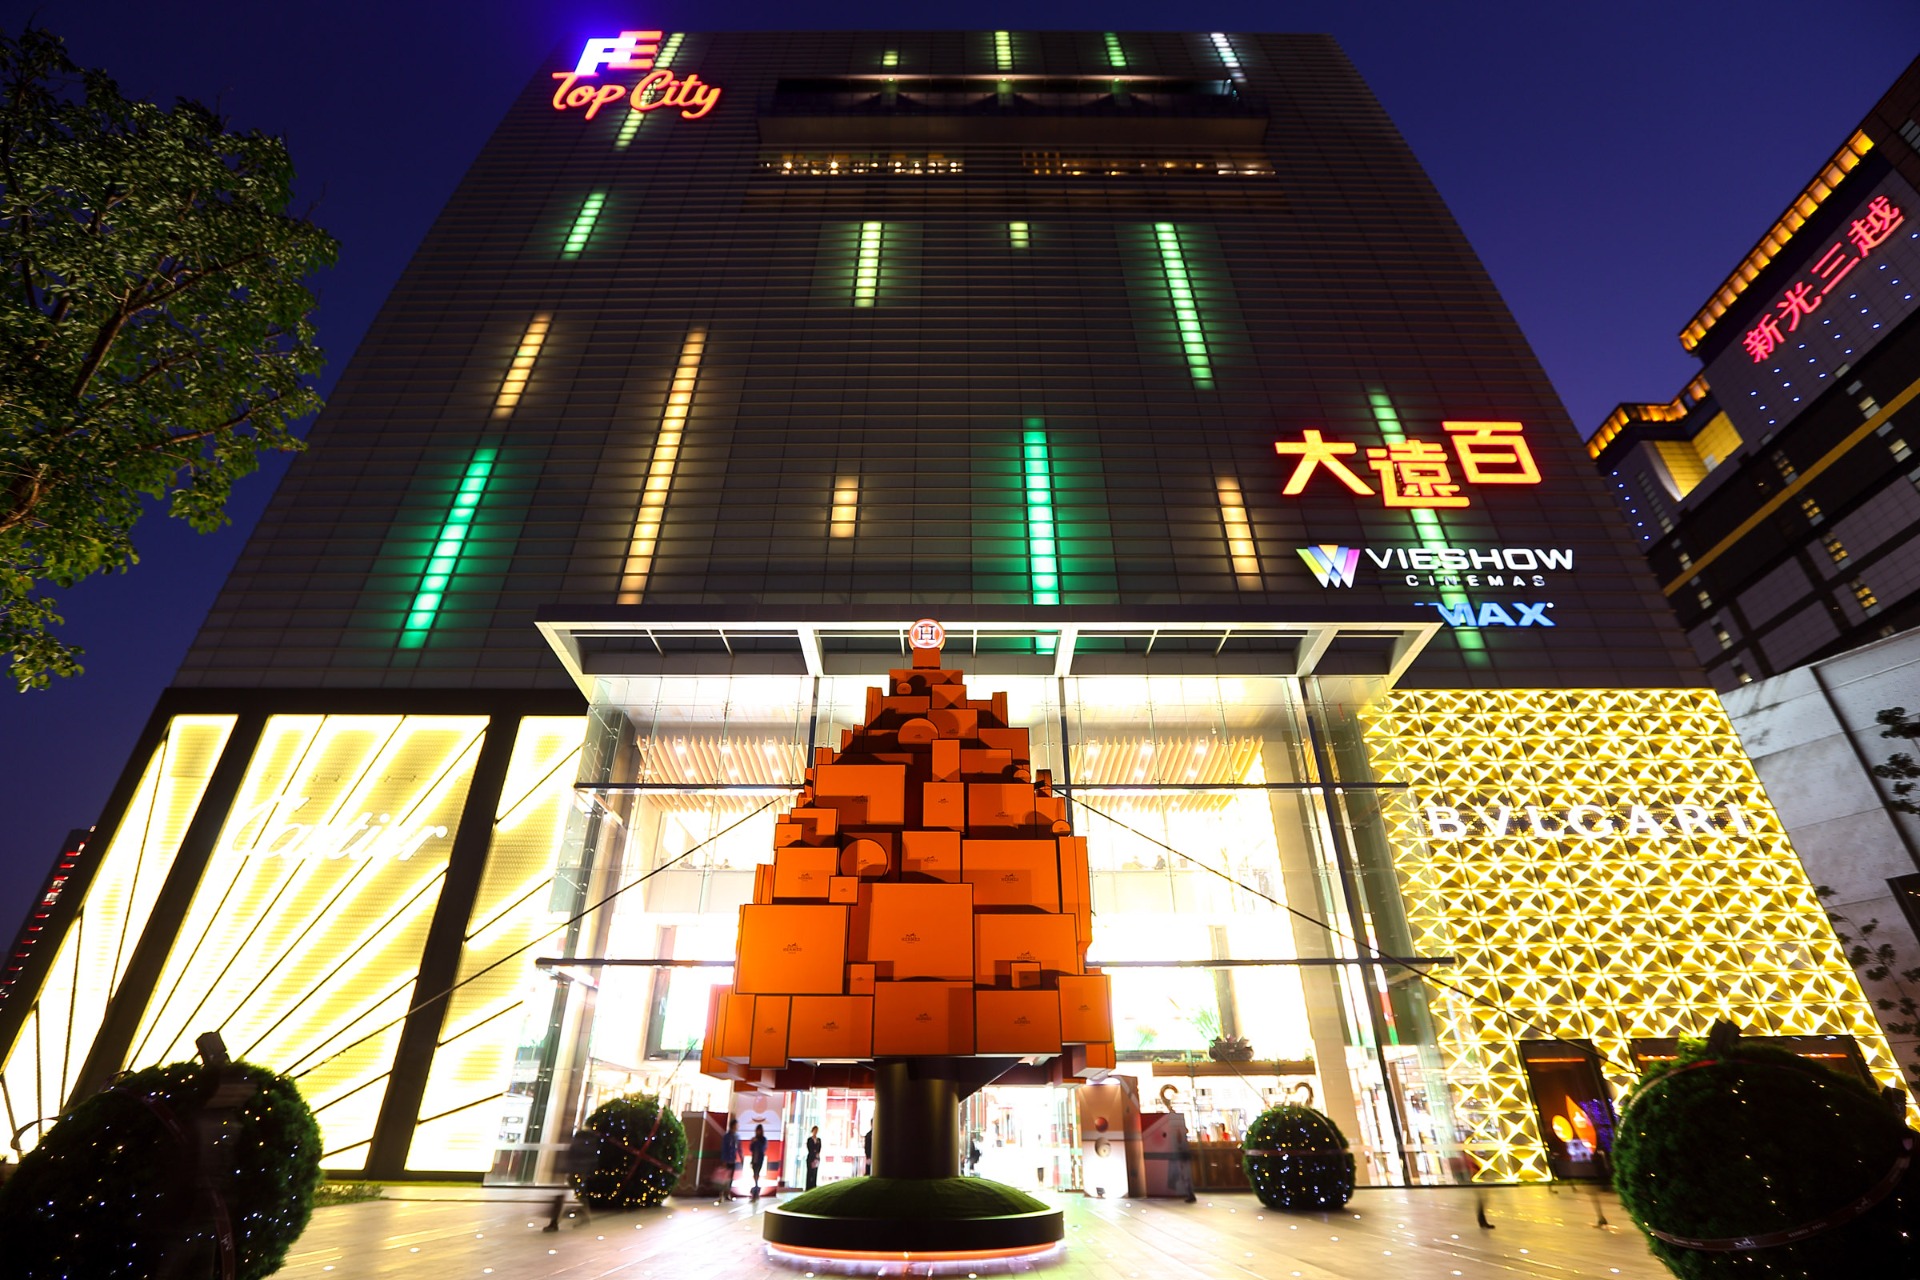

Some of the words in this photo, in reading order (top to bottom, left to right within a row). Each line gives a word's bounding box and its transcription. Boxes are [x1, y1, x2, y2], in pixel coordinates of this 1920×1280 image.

[574, 30, 663, 75] FE
[551, 71, 627, 120] Top
[629, 69, 722, 119] City
[1742, 195, 1905, 364] 新光三越
[1274, 420, 1543, 508] 大遠百
[1365, 548, 1574, 570] VIESHOW
[1405, 574, 1546, 587] CINEMAS
[1413, 601, 1556, 627] MAX
[918, 625, 936, 641] H
[1424, 803, 1753, 840] BVLGARI
